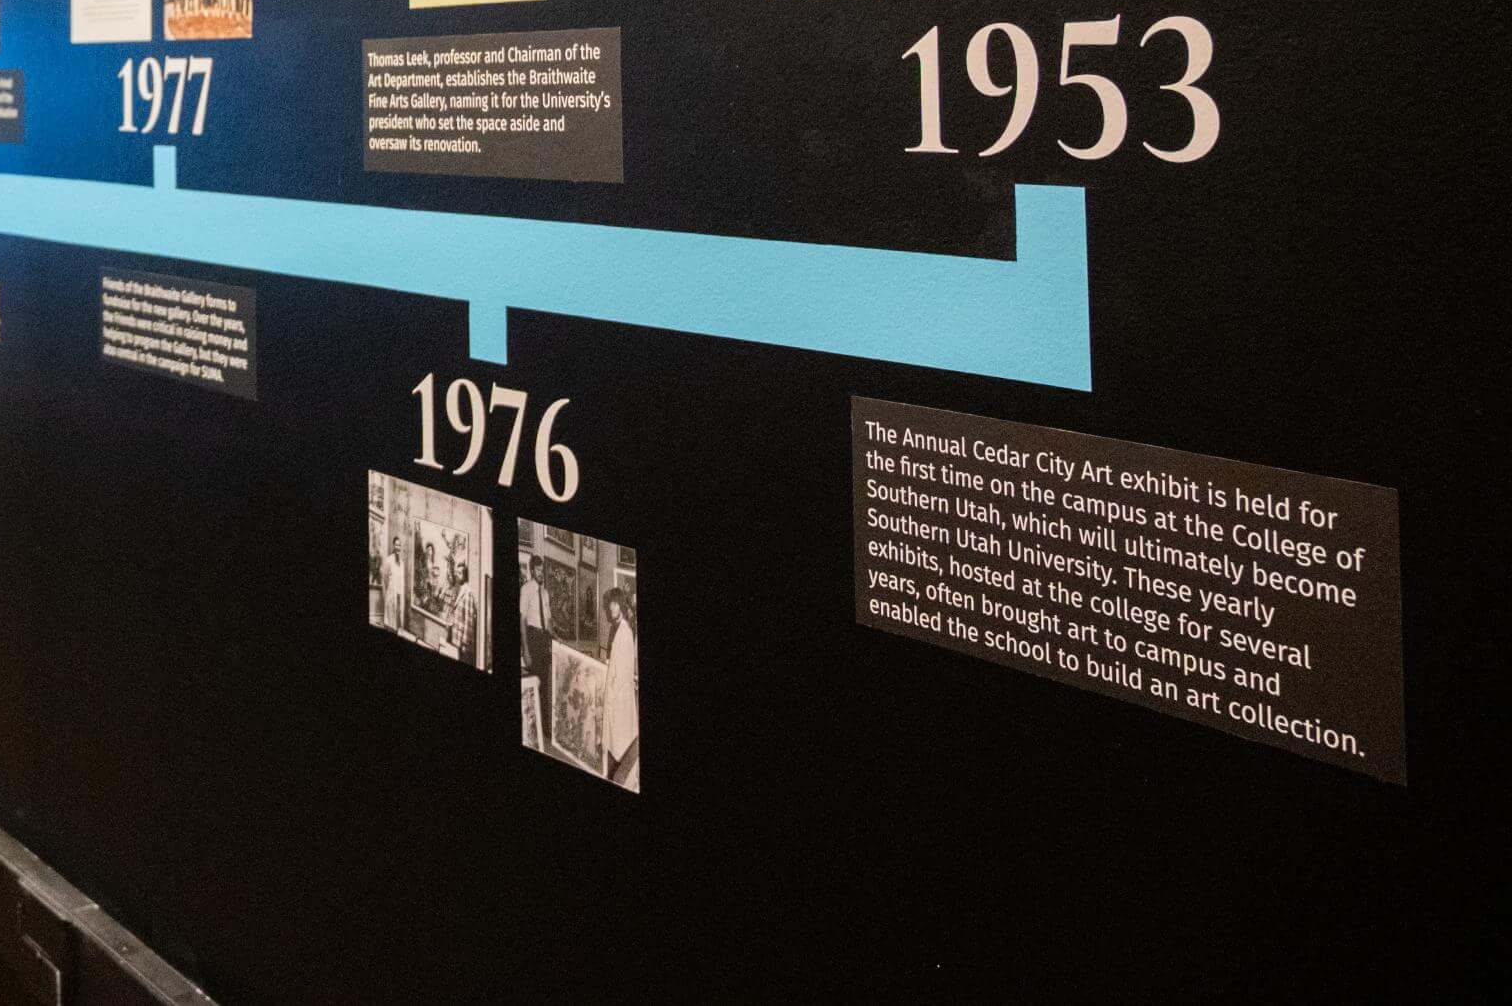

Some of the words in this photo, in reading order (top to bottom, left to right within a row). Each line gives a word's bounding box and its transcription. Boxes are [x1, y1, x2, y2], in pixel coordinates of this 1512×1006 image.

[118, 55, 213, 135] 1977
[367, 51, 404, 66] Thomas
[406, 50, 431, 67] Leek,
[433, 48, 481, 68] professor
[484, 46, 504, 63] and
[507, 45, 561, 62] Chairman
[565, 43, 577, 60] of
[579, 43, 600, 59] the
[368, 73, 381, 87] Art
[384, 72, 443, 89] Department,
[445, 69, 504, 86] establishes
[507, 69, 525, 85] the
[529, 66, 595, 84] Braithwaite
[368, 92, 387, 108] Fine
[389, 89, 408, 108] Arts
[410, 92, 447, 110] Gallery,
[450, 92, 488, 111] naming
[490, 91, 498, 107] it
[501, 91, 517, 107] for
[520, 92, 538, 107] the
[542, 90, 610, 111] University's
[902, 14, 1220, 162] 1953
[369, 113, 413, 131] president
[415, 114, 435, 129] who
[438, 116, 454, 129] set
[456, 114, 473, 130] the
[476, 111, 507, 133] space
[510, 114, 539, 131] aside
[542, 115, 564, 131] and
[369, 137, 407, 149] oversaw
[409, 134, 421, 150] its
[423, 136, 480, 152] renovation.
[412, 373, 579, 503] 1976
[865, 421, 896, 443] The
[902, 428, 966, 457] Annual
[973, 440, 1029, 467] Cedar
[1036, 451, 1074, 481] City
[1081, 460, 1112, 485] Art
[1120, 471, 1199, 502] exhibit
[1208, 481, 1226, 507] is
[1236, 488, 1289, 520] held
[1299, 500, 1337, 528] for
[866, 450, 894, 472] the
[900, 455, 935, 480] first
[941, 464, 983, 490] time
[990, 478, 1014, 496] on
[1021, 480, 1054, 504] the
[1062, 493, 1146, 524] campus
[1154, 511, 1176, 531] at
[1184, 514, 1222, 541] the
[1233, 524, 1326, 566] College
[1336, 547, 1364, 570] of
[867, 479, 948, 513] Southern
[956, 497, 1005, 529] Utah,
[1012, 511, 1070, 540] which
[1079, 525, 1116, 551] will
[1125, 535, 1243, 584] ultimately
[1253, 561, 1355, 606] become
[868, 507, 948, 543] Southern
[957, 527, 1000, 555] Utah
[1009, 540, 1116, 586] University.
[1124, 566, 1191, 601] These
[1200, 589, 1274, 626] yearly
[868, 540, 942, 575] exhibits,
[950, 555, 1014, 590] hosted
[1022, 578, 1041, 597] at
[1048, 582, 1082, 607] the
[1090, 596, 1169, 632] college
[1178, 613, 1211, 640] for
[1220, 629, 1310, 668] several
[868, 569, 919, 599] years,
[926, 582, 973, 610] often
[982, 594, 1060, 634] brought
[1067, 622, 1097, 644] art
[1104, 629, 1126, 651] to
[1135, 641, 1225, 679] campus
[1234, 668, 1279, 695] and
[869, 599, 940, 631] enabled
[947, 617, 977, 641] the
[985, 630, 1050, 663] school
[1058, 648, 1078, 670] to
[1087, 654, 1140, 689] build
[1150, 678, 1177, 700] an
[1187, 689, 1220, 713] art
[1229, 701, 1363, 756] collection.
